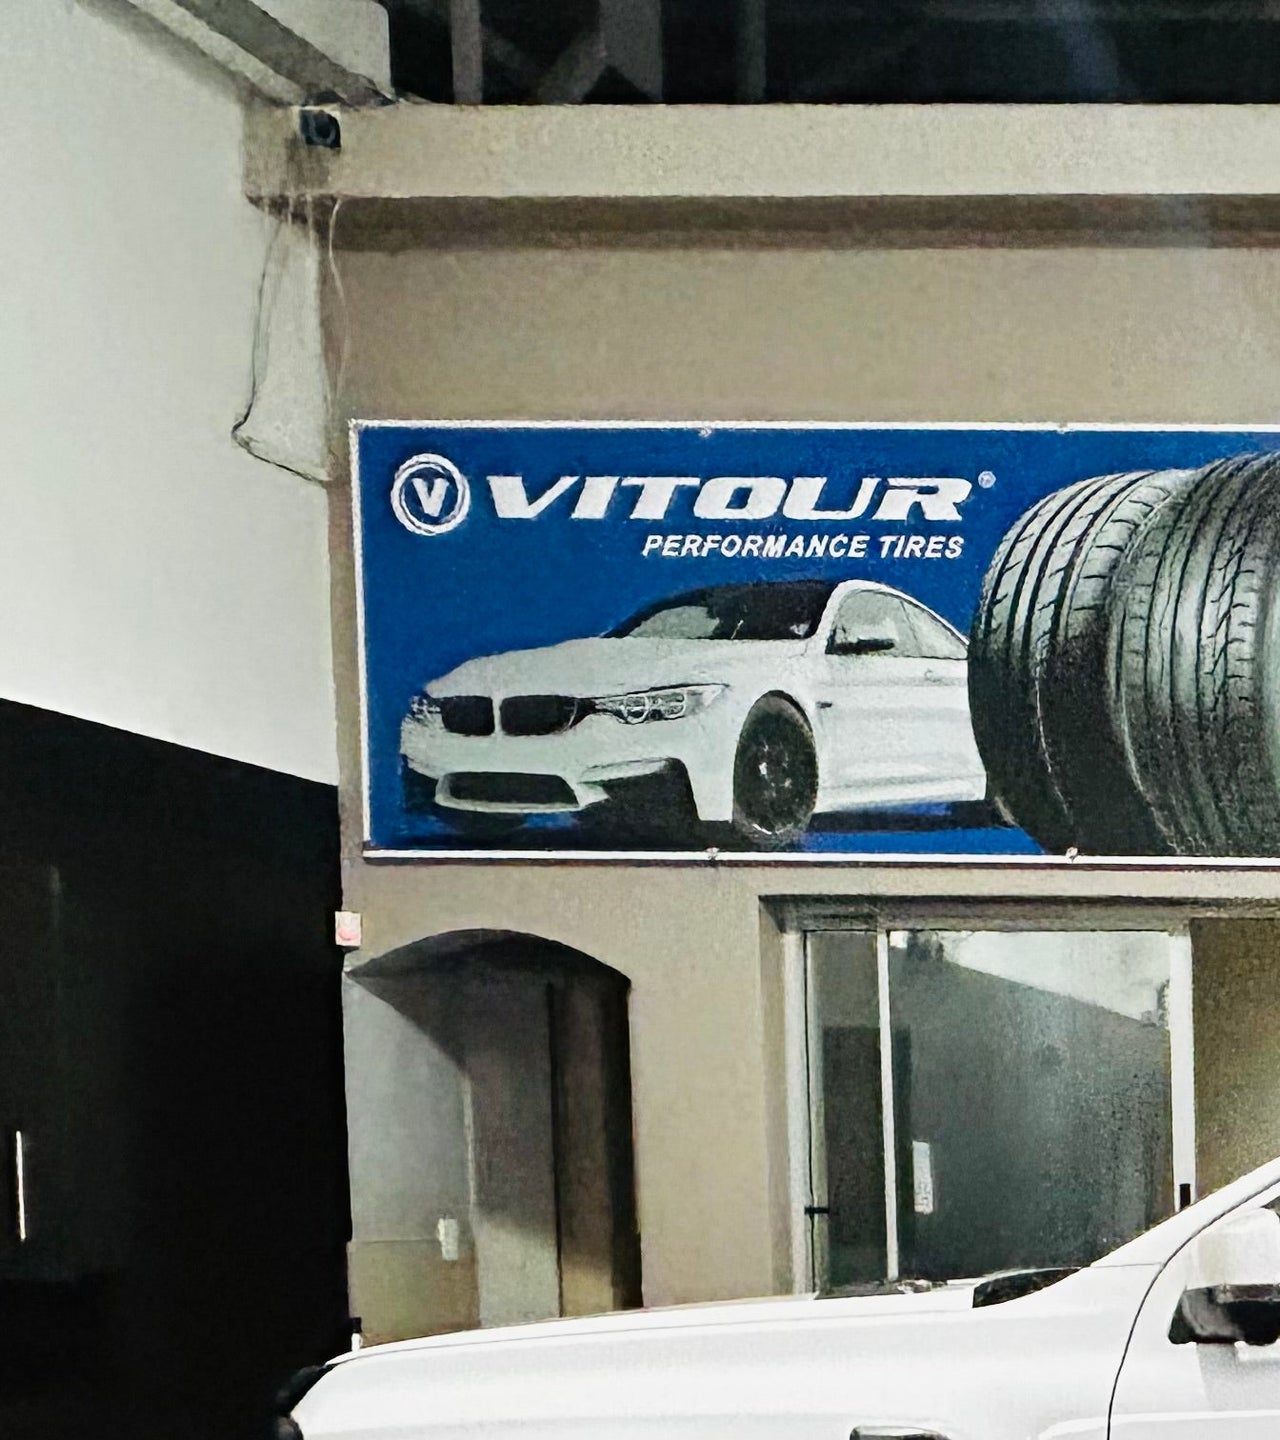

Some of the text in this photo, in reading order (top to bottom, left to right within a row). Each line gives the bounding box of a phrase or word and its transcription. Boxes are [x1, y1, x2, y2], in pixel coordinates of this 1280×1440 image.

[486, 475, 972, 521] VITOUR
[641, 534, 965, 559] PERFORMANCE TIRES
